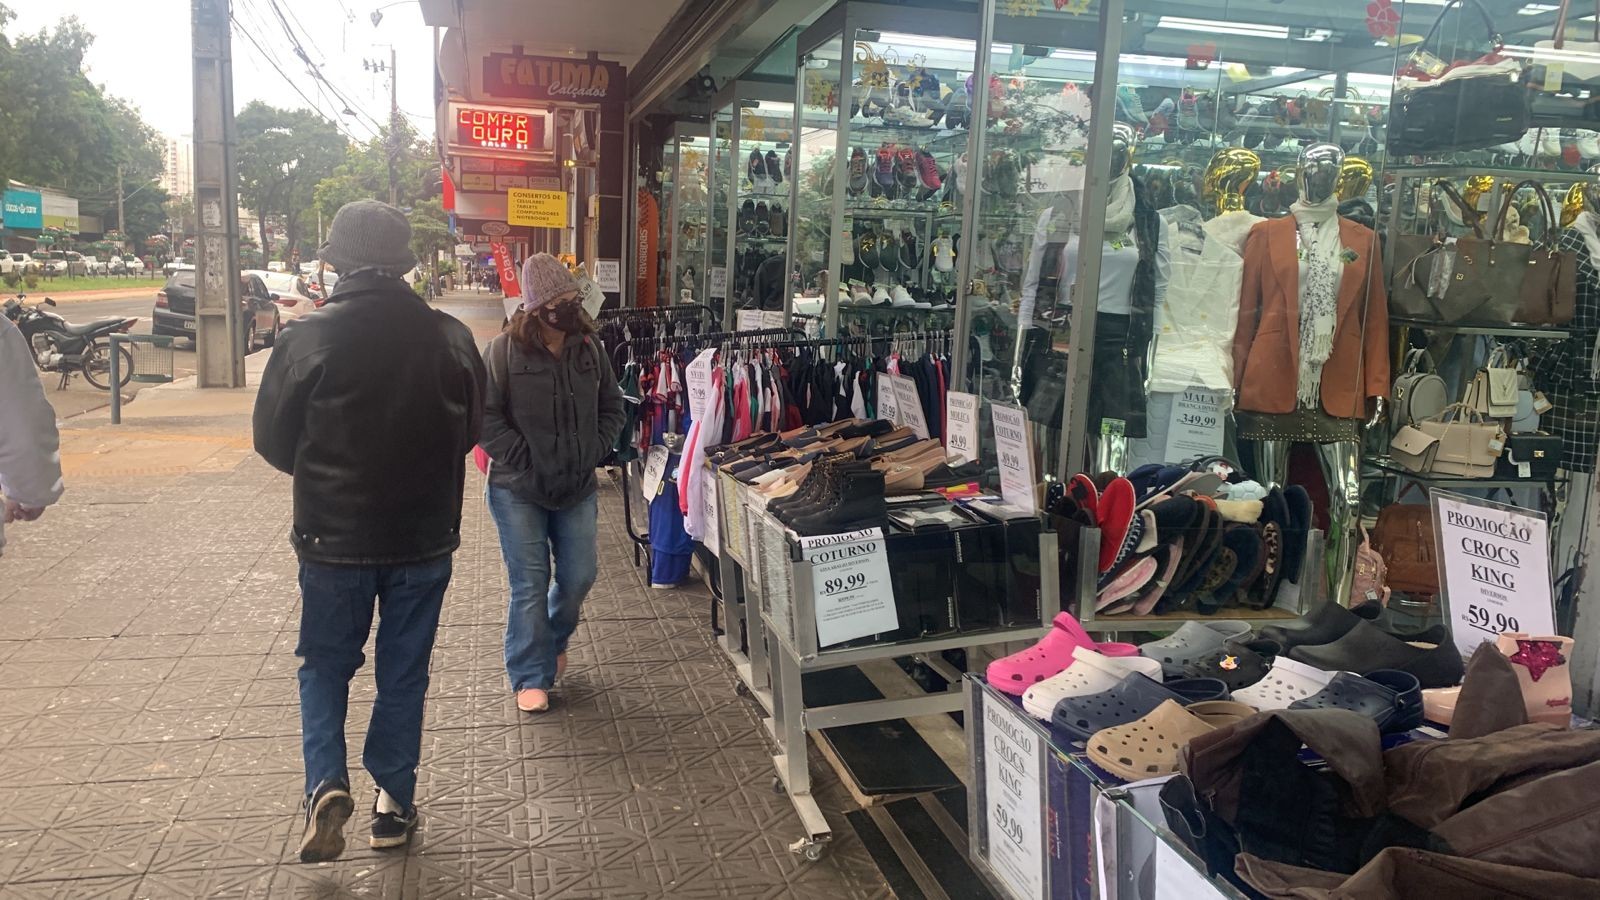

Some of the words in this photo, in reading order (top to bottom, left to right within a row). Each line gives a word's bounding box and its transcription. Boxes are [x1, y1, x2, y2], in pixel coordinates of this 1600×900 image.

[547, 81, 607, 98] Calçados
[461, 110, 528, 128] COMPR
[473, 126, 528, 143] OURO
[513, 191, 551, 199] CONSERTOS
[500, 245, 514, 281] Claro
[637, 228, 649, 280] havaianas
[1183, 391, 1216, 404] MALA
[994, 410, 1020, 426] PROMOÇÃO
[1183, 413, 1216, 427] 349,99
[995, 424, 1022, 441] COTURNO
[1447, 510, 1530, 542] PROMOÇÃO
[810, 542, 876, 565] COTURNO
[1461, 537, 1520, 566] CROCS
[824, 572, 866, 595] 89,99
[1471, 563, 1516, 589] KING
[1468, 604, 1520, 634] 59,99
[986, 705, 1032, 754] PROMOÇÃO
[994, 735, 1025, 775] CROCS
[999, 762, 1022, 797] KING
[996, 803, 1023, 844] 59,99
